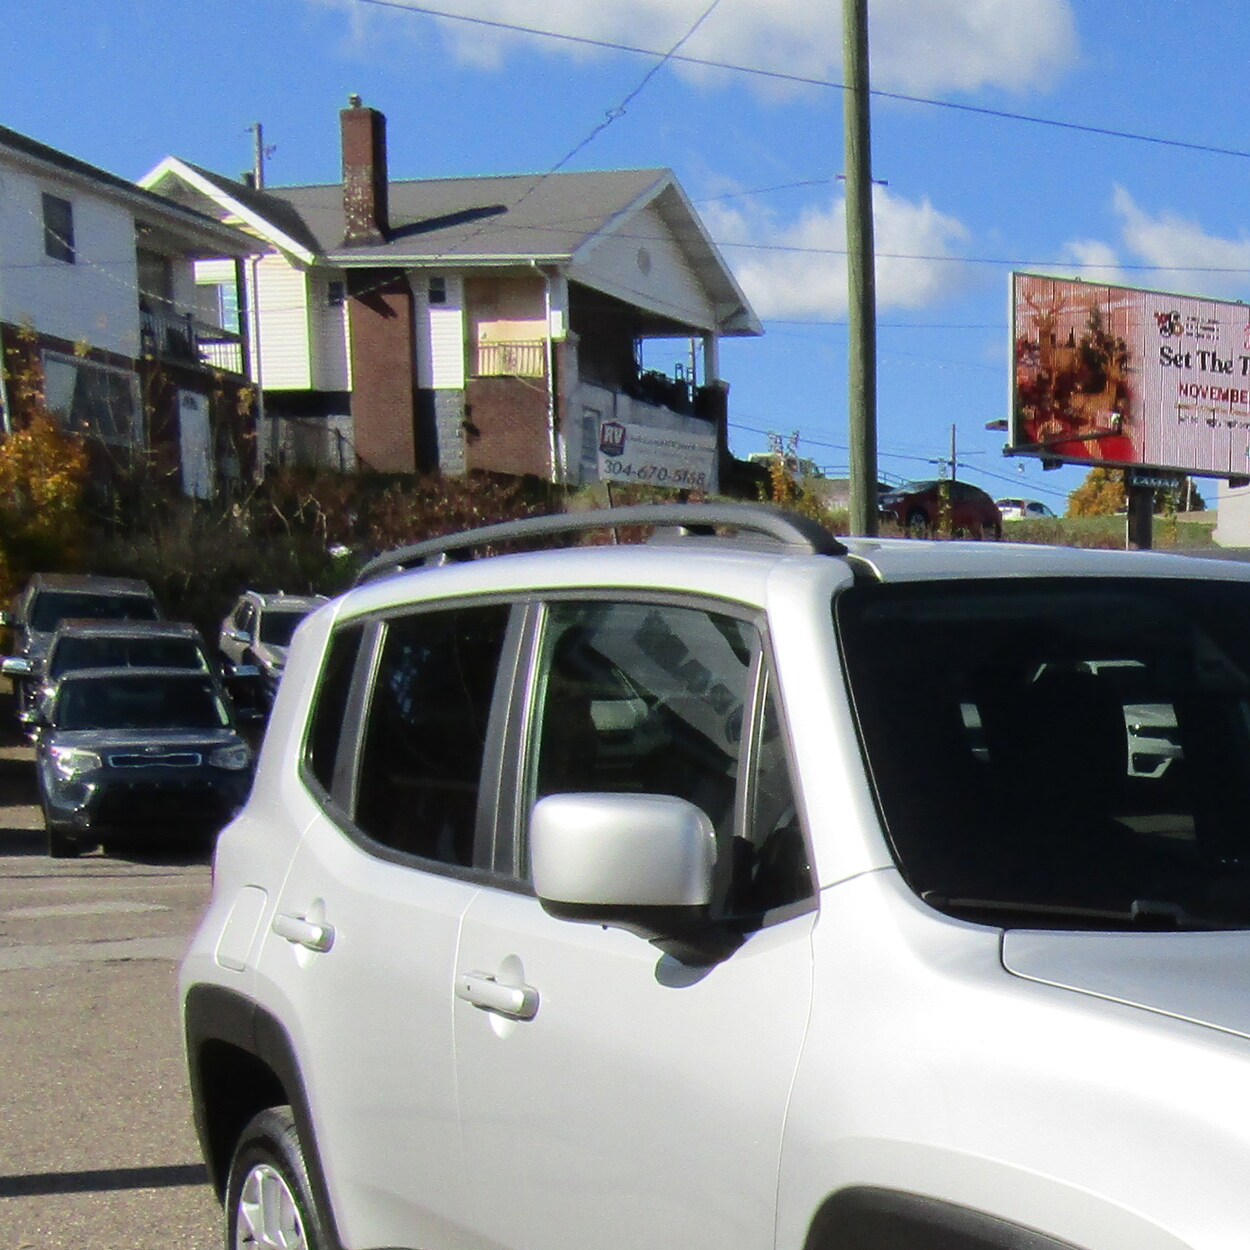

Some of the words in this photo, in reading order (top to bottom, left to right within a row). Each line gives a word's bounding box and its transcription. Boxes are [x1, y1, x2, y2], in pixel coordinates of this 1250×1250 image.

[1159, 345, 1192, 370] Set
[1196, 350, 1233, 375] The
[1132, 476, 1179, 489] LAMAR
